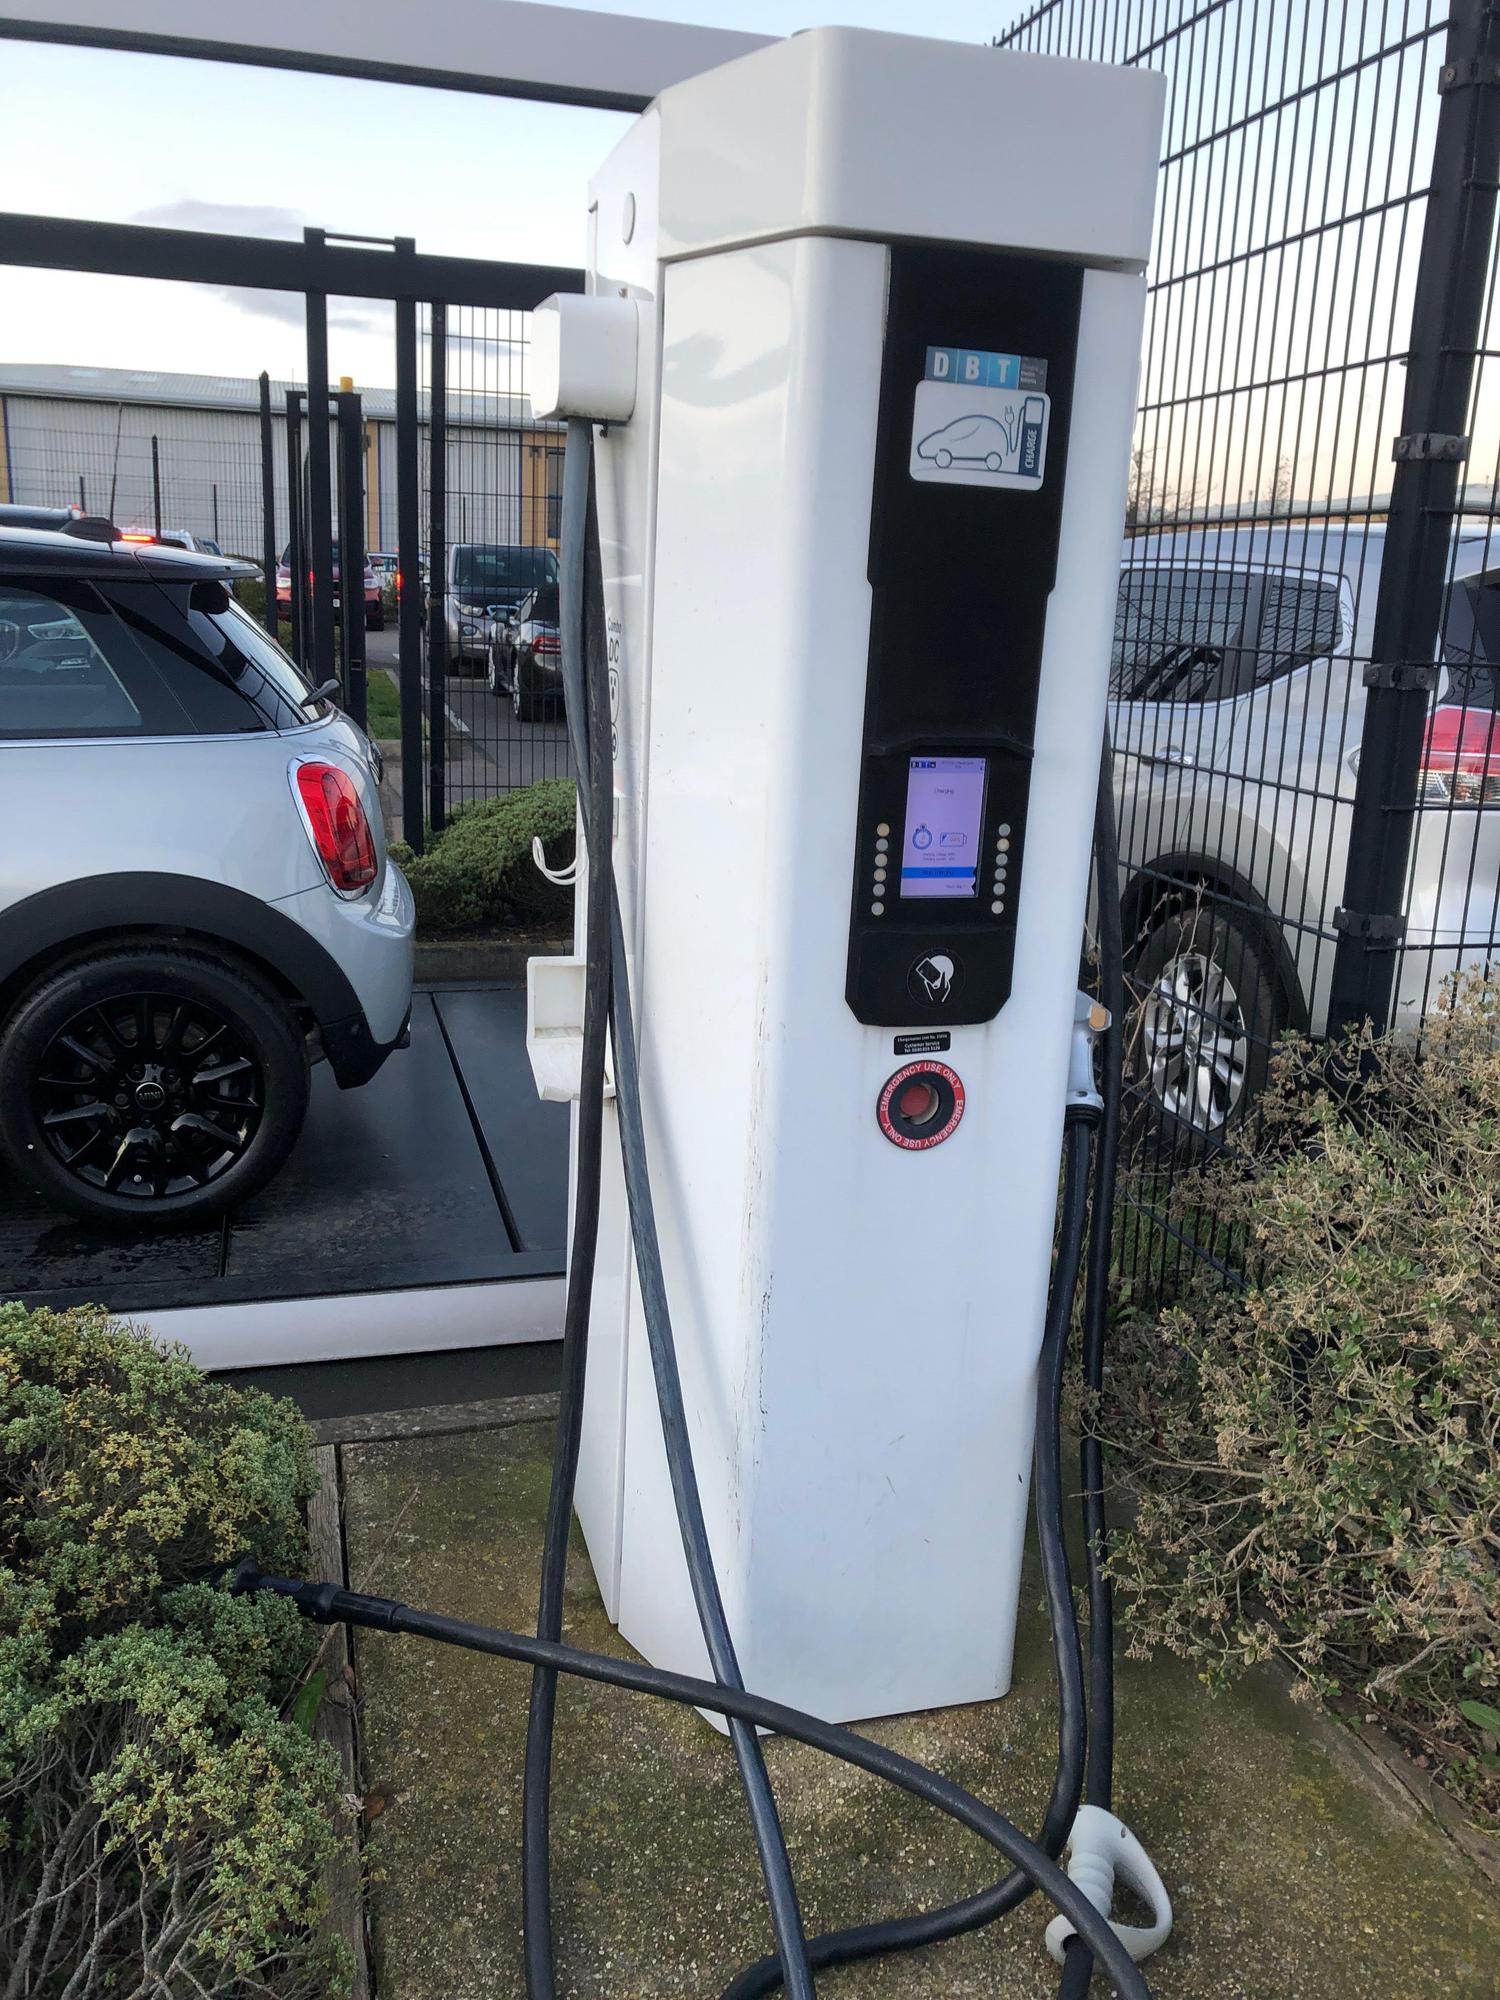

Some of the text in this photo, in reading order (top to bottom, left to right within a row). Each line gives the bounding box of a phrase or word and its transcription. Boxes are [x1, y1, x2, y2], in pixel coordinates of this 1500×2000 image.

[1024, 429, 1037, 469] CHARGE
[608, 639, 620, 663] DC
[881, 1062, 961, 1112] EMERGENCY USE ONLY
[882, 1099, 964, 1148] EMERGENCY USE ONLY
